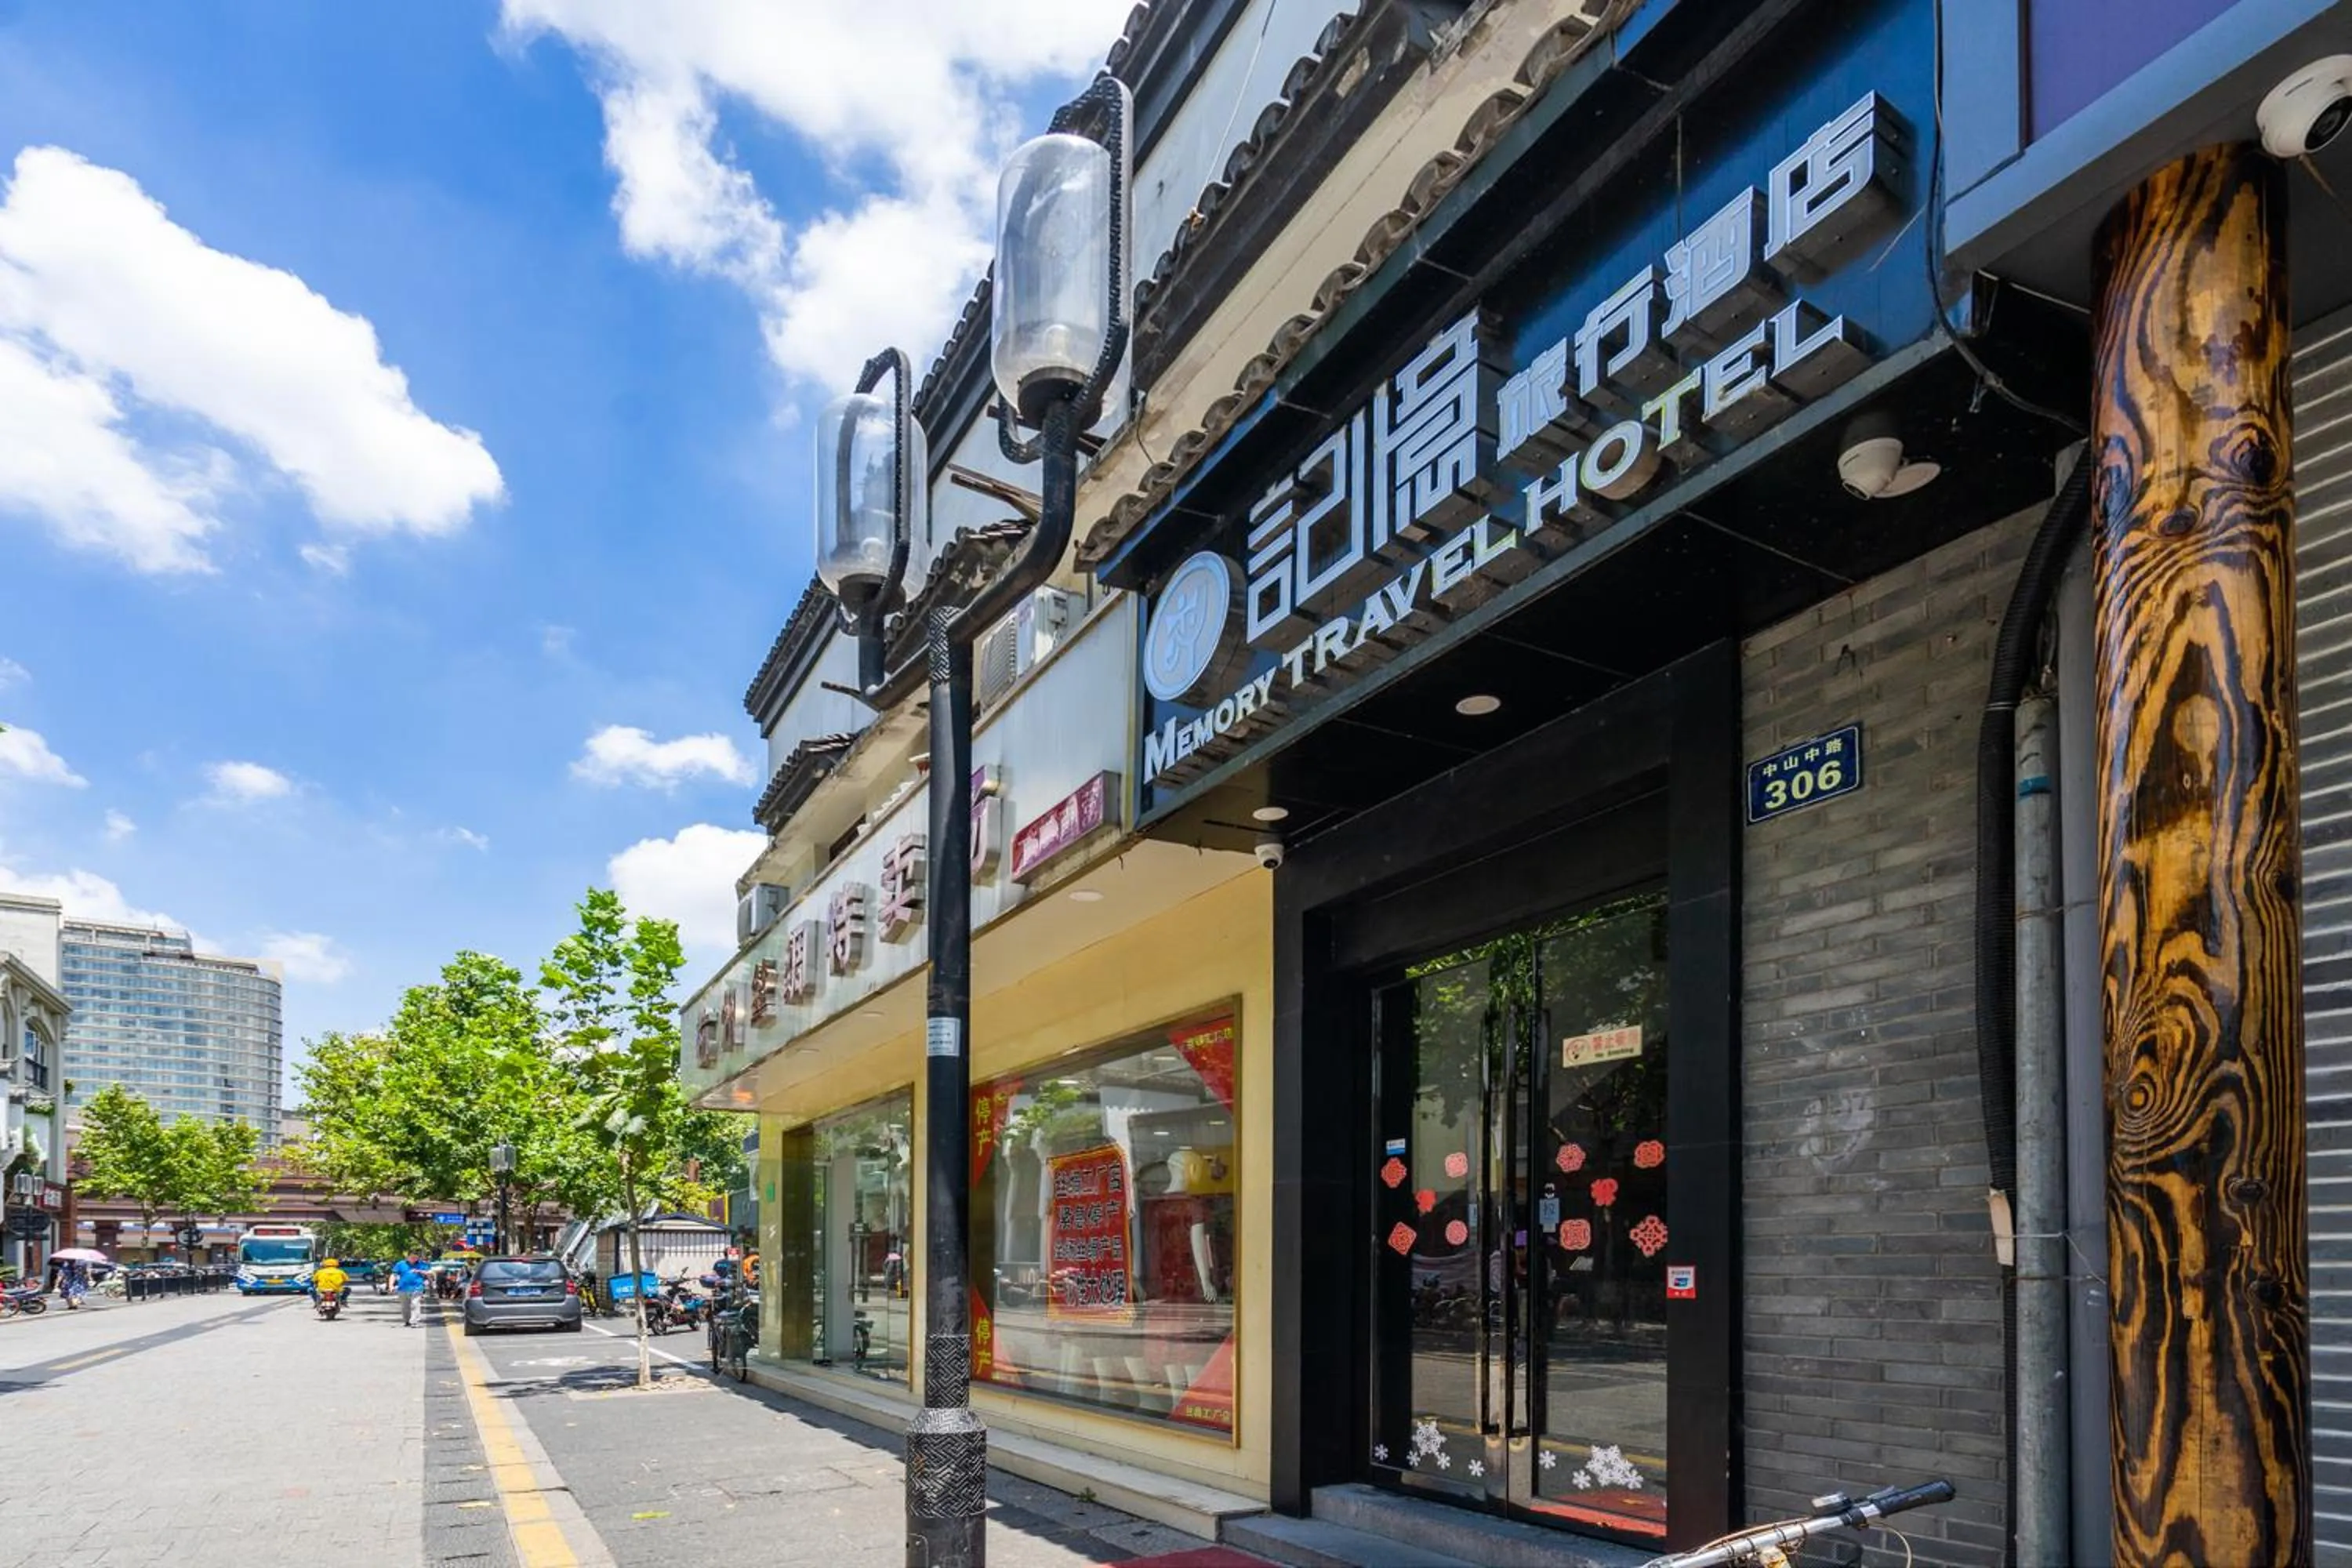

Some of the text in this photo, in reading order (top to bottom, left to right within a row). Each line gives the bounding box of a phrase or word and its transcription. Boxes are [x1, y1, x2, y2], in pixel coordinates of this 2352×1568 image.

[1144, 666, 1276, 784] MEMORY
[1282, 514, 1517, 690] TRAVEL
[1523, 298, 1843, 537] HOTEL
[1762, 738, 1842, 777] 中山中路
[1765, 760, 1842, 808] 306
[975, 1095, 992, 1156] 停产
[1058, 1200, 1120, 1230] 紧急停产
[975, 1316, 991, 1375] 停产
